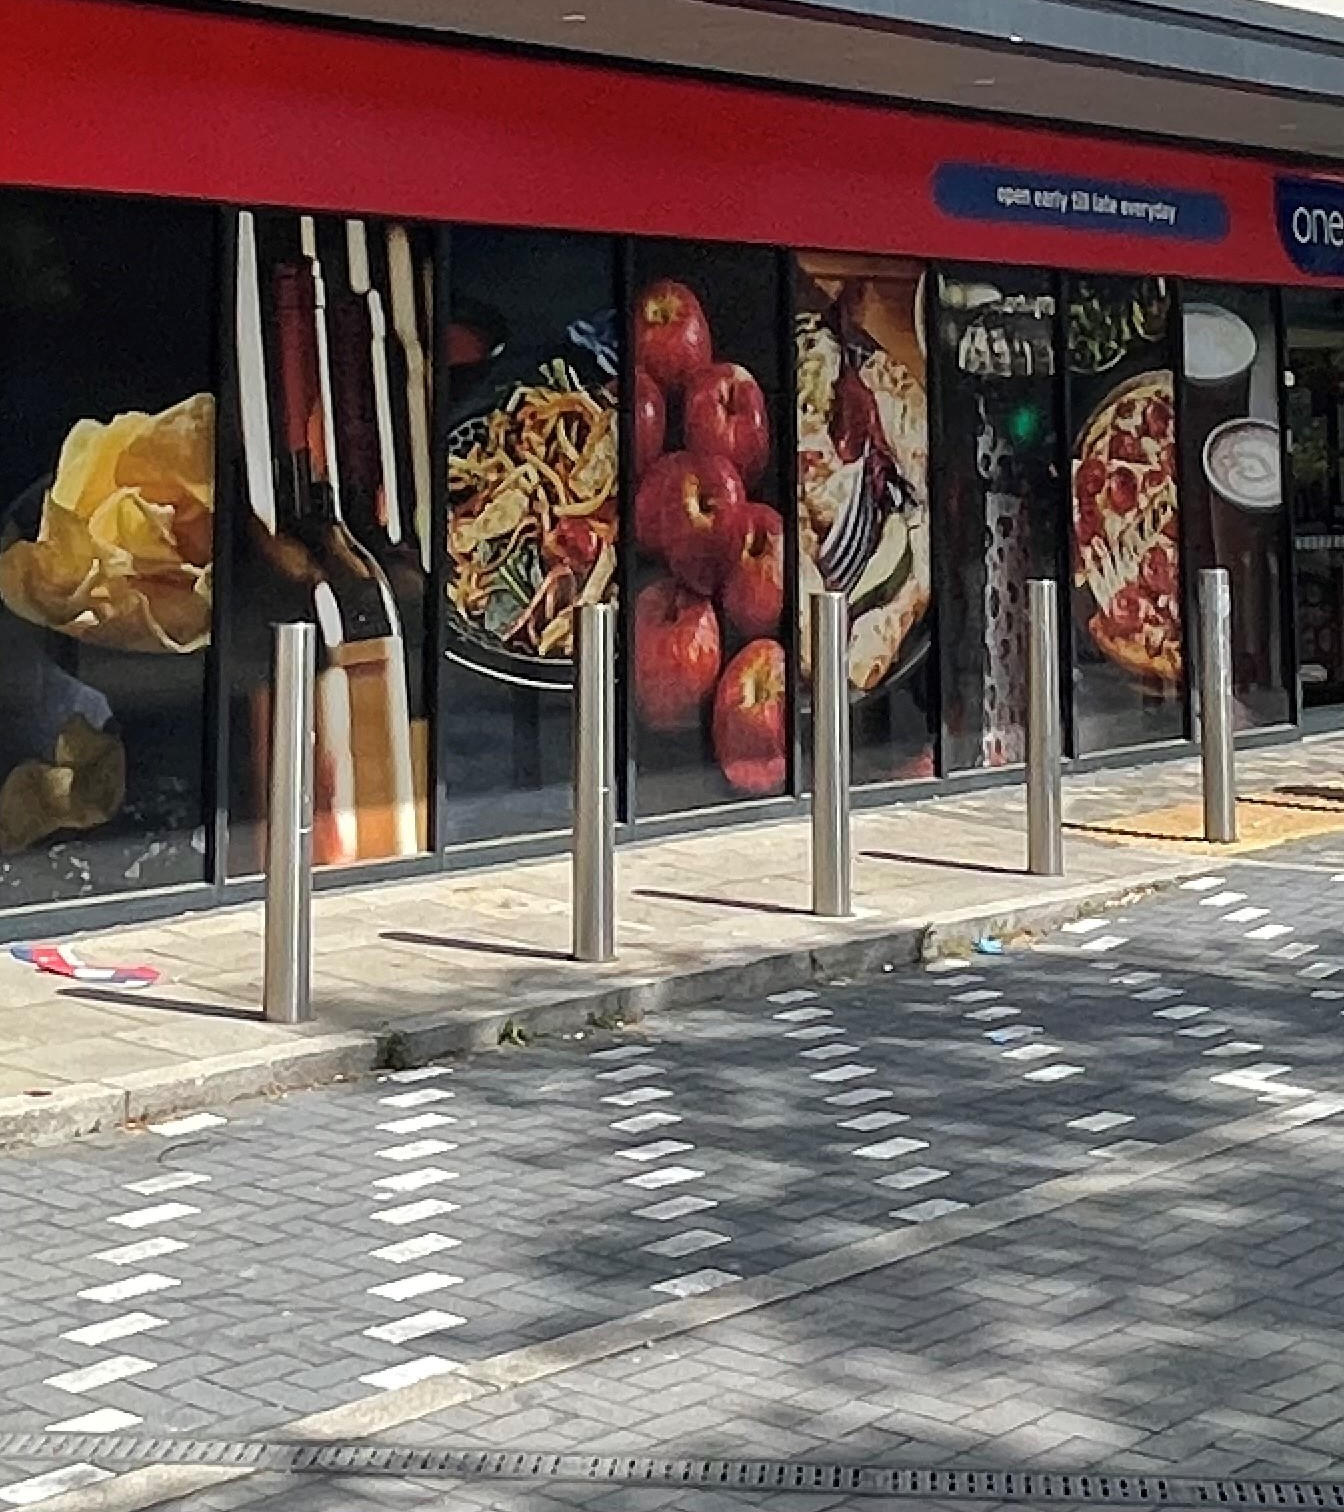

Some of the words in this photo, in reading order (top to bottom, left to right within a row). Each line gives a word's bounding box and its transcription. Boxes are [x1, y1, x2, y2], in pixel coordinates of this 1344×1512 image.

[997, 187, 1030, 206] open
[1034, 190, 1068, 214] early
[1071, 191, 1090, 211] till
[1092, 193, 1118, 214] late
[1120, 200, 1177, 226] everyday
[1292, 206, 1344, 247] one
